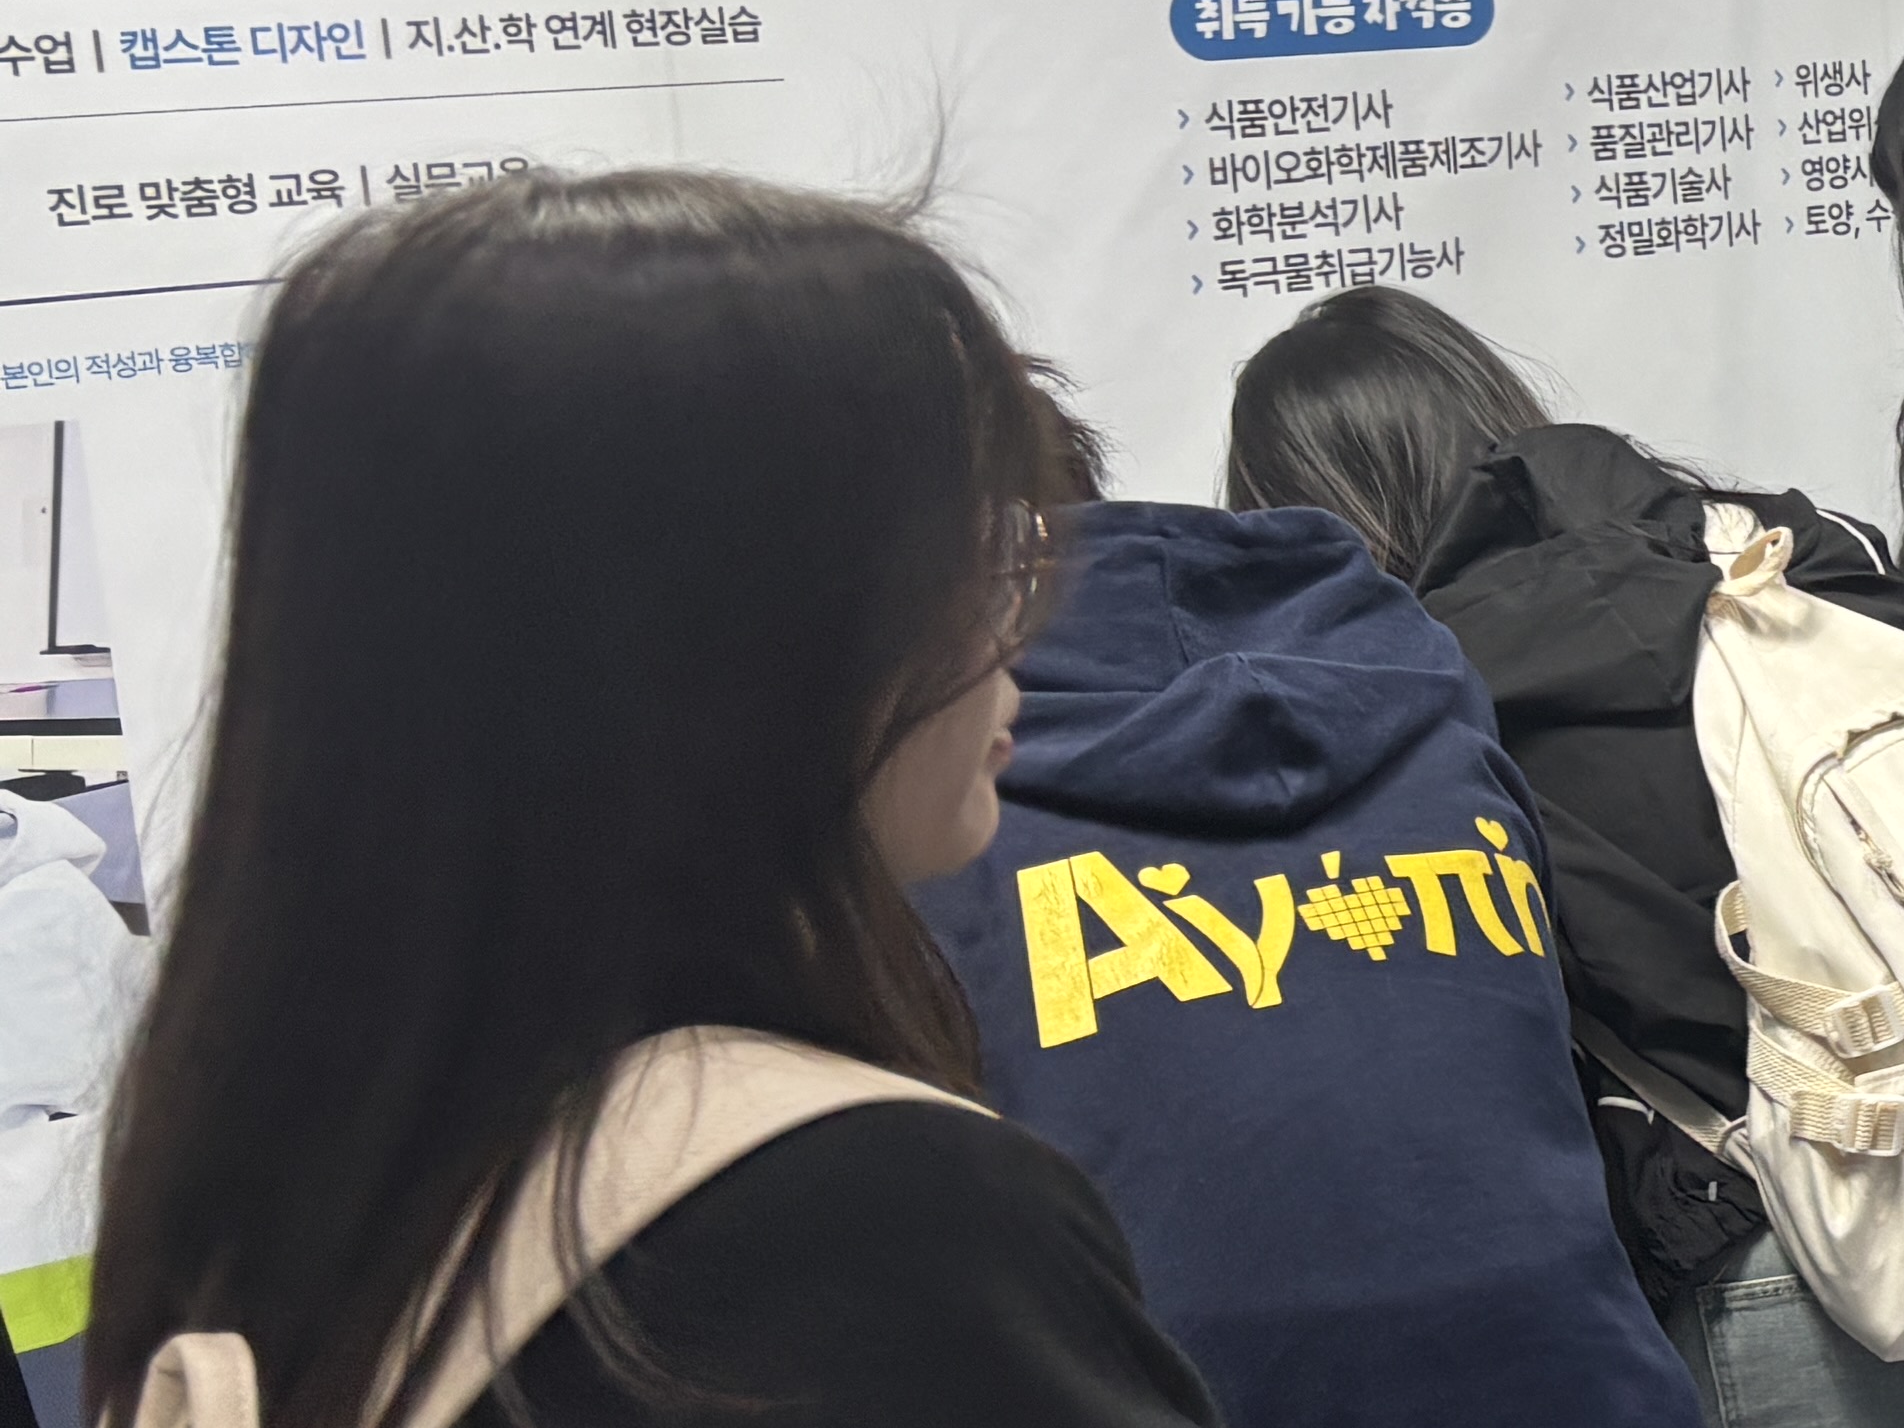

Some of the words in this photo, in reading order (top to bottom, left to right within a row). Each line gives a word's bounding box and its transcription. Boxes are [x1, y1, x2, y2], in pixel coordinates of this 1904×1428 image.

[120, 26, 241, 70] 캡스톤
[250, 19, 366, 63] 디자인
[406, 13, 537, 56] 지.산.학
[545, 10, 617, 50] 연계
[623, 6, 762, 47] 현장실습
[1587, 66, 1751, 112] 식품산업기사
[1795, 60, 1871, 98] 위생사
[1205, 89, 1393, 140] 식품안전기사
[1590, 113, 1754, 161] 품질관리기사
[1208, 128, 1543, 194] 바이오화학제품제조기사
[47, 185, 133, 227] 진로
[139, 173, 257, 220] 맞춤형
[269, 169, 345, 208] 교육
[1595, 163, 1731, 209] 식품기술사
[1212, 192, 1404, 245] 화학분석기사
[1598, 209, 1761, 258] 정밀화학기사
[1805, 200, 1859, 239] 토양,
[1217, 237, 1465, 298] 독극물취급기능사
[0, 356, 80, 390] 본인의
[85, 348, 164, 380] 적성과
